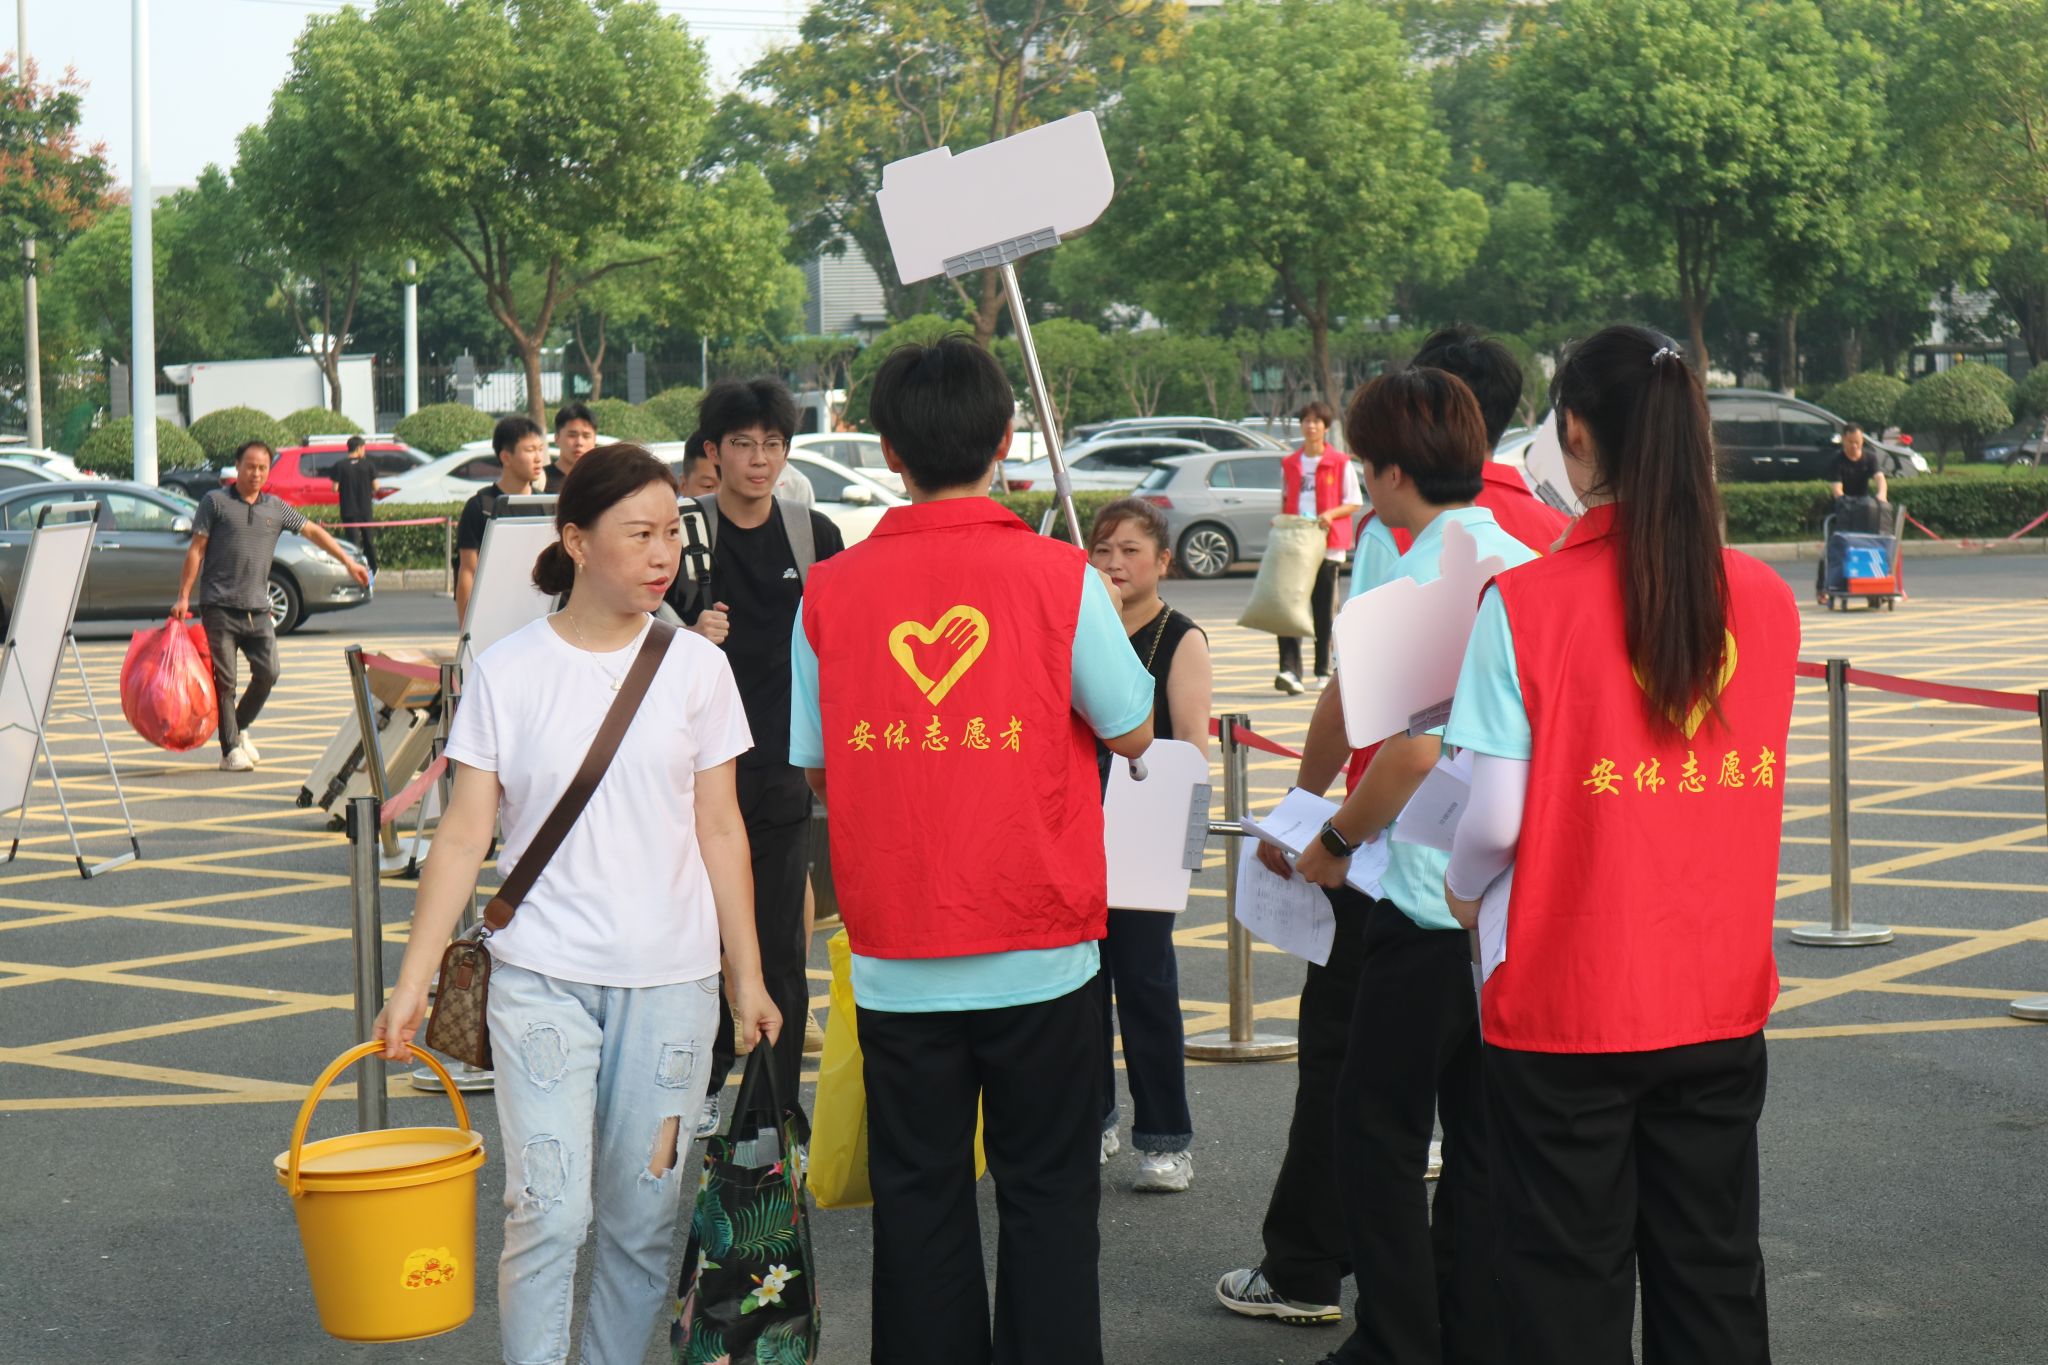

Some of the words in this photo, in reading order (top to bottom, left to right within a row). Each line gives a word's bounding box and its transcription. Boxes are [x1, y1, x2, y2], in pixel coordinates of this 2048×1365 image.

[847, 715, 1023, 753] 安体志愿者
[1583, 746, 1777, 795] 安体志愿者
